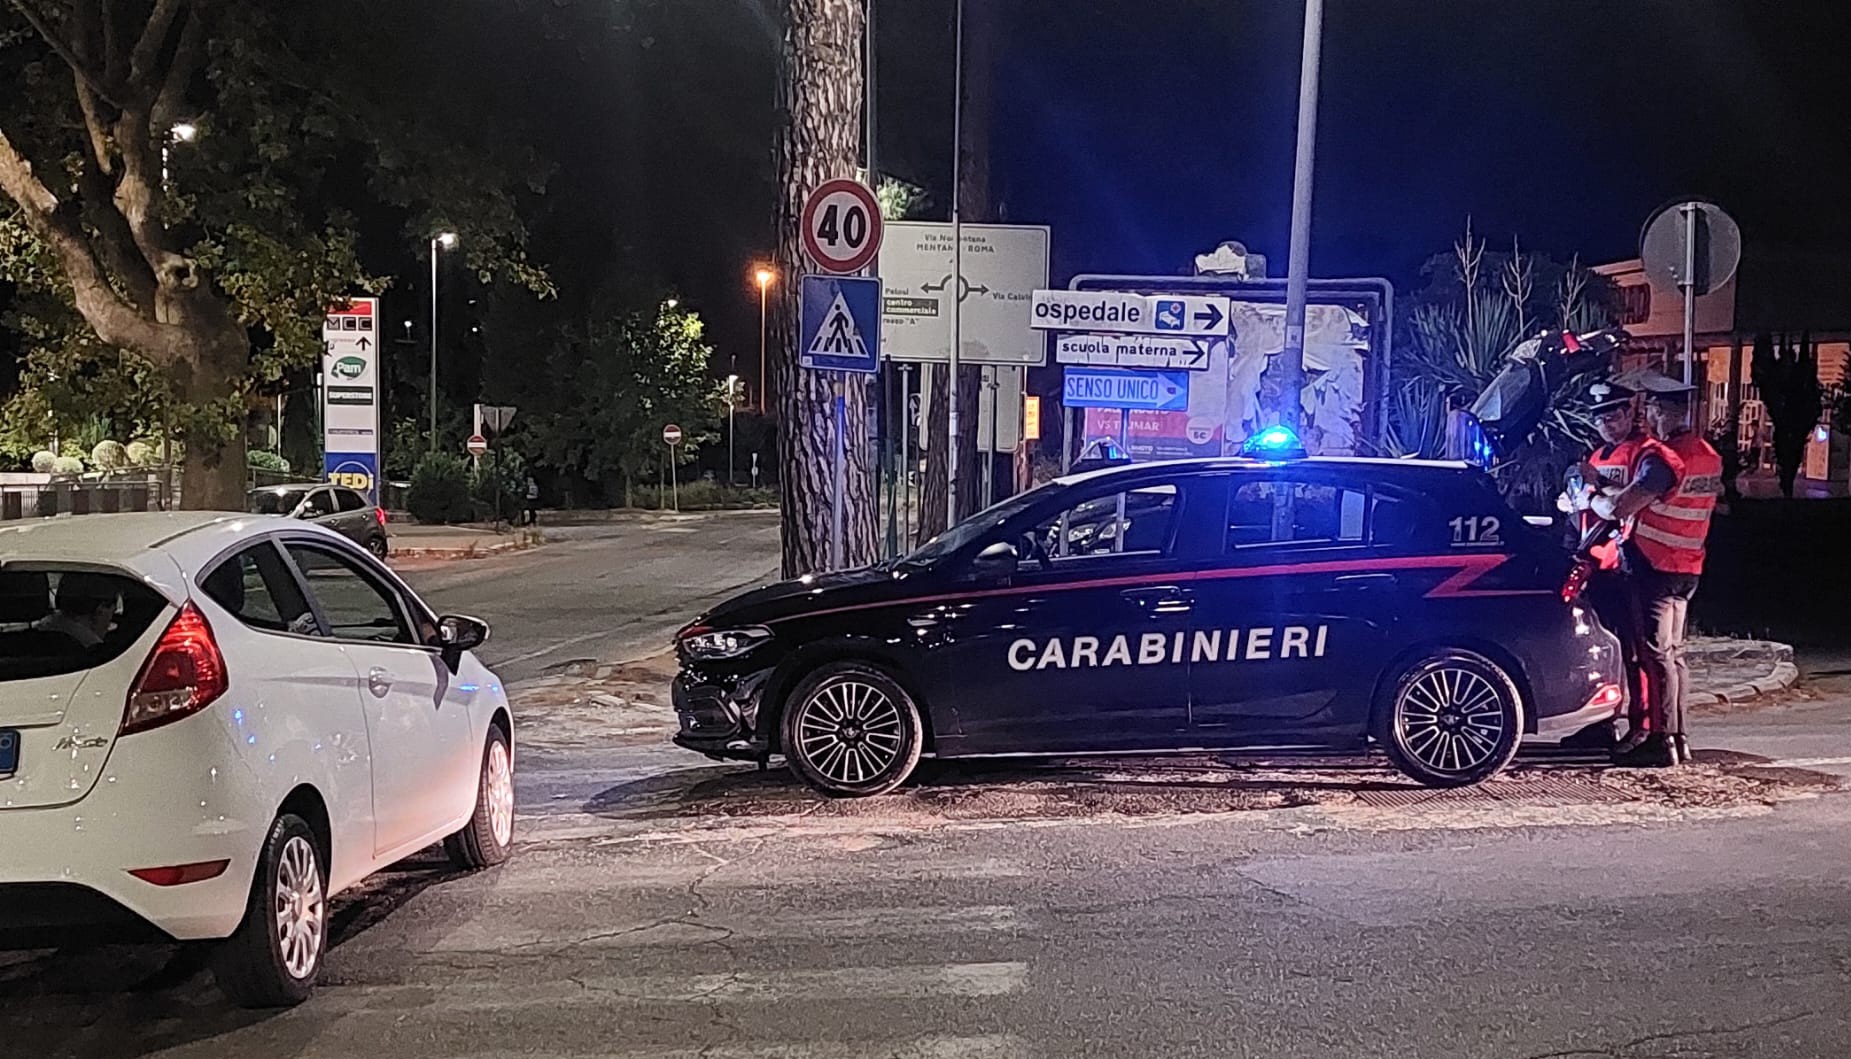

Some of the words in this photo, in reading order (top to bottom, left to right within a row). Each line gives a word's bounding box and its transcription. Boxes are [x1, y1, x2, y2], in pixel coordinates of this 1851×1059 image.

[817, 204, 866, 248] 40
[924, 234, 937, 242] Via
[916, 243, 954, 251] MENTAN
[886, 298, 913, 307] centro
[992, 292, 1005, 300] Via
[886, 306, 937, 315] commerciale
[1035, 300, 1140, 324] ospedale
[1062, 342, 1110, 354] scuola
[1116, 345, 1177, 357] materna
[336, 361, 362, 376] Pam
[1067, 376, 1112, 399] SENSO
[1117, 378, 1159, 400] UNICO
[328, 472, 374, 490] TEDi
[1448, 516, 1500, 542] 112
[1007, 625, 1328, 671] CARABINIERI
